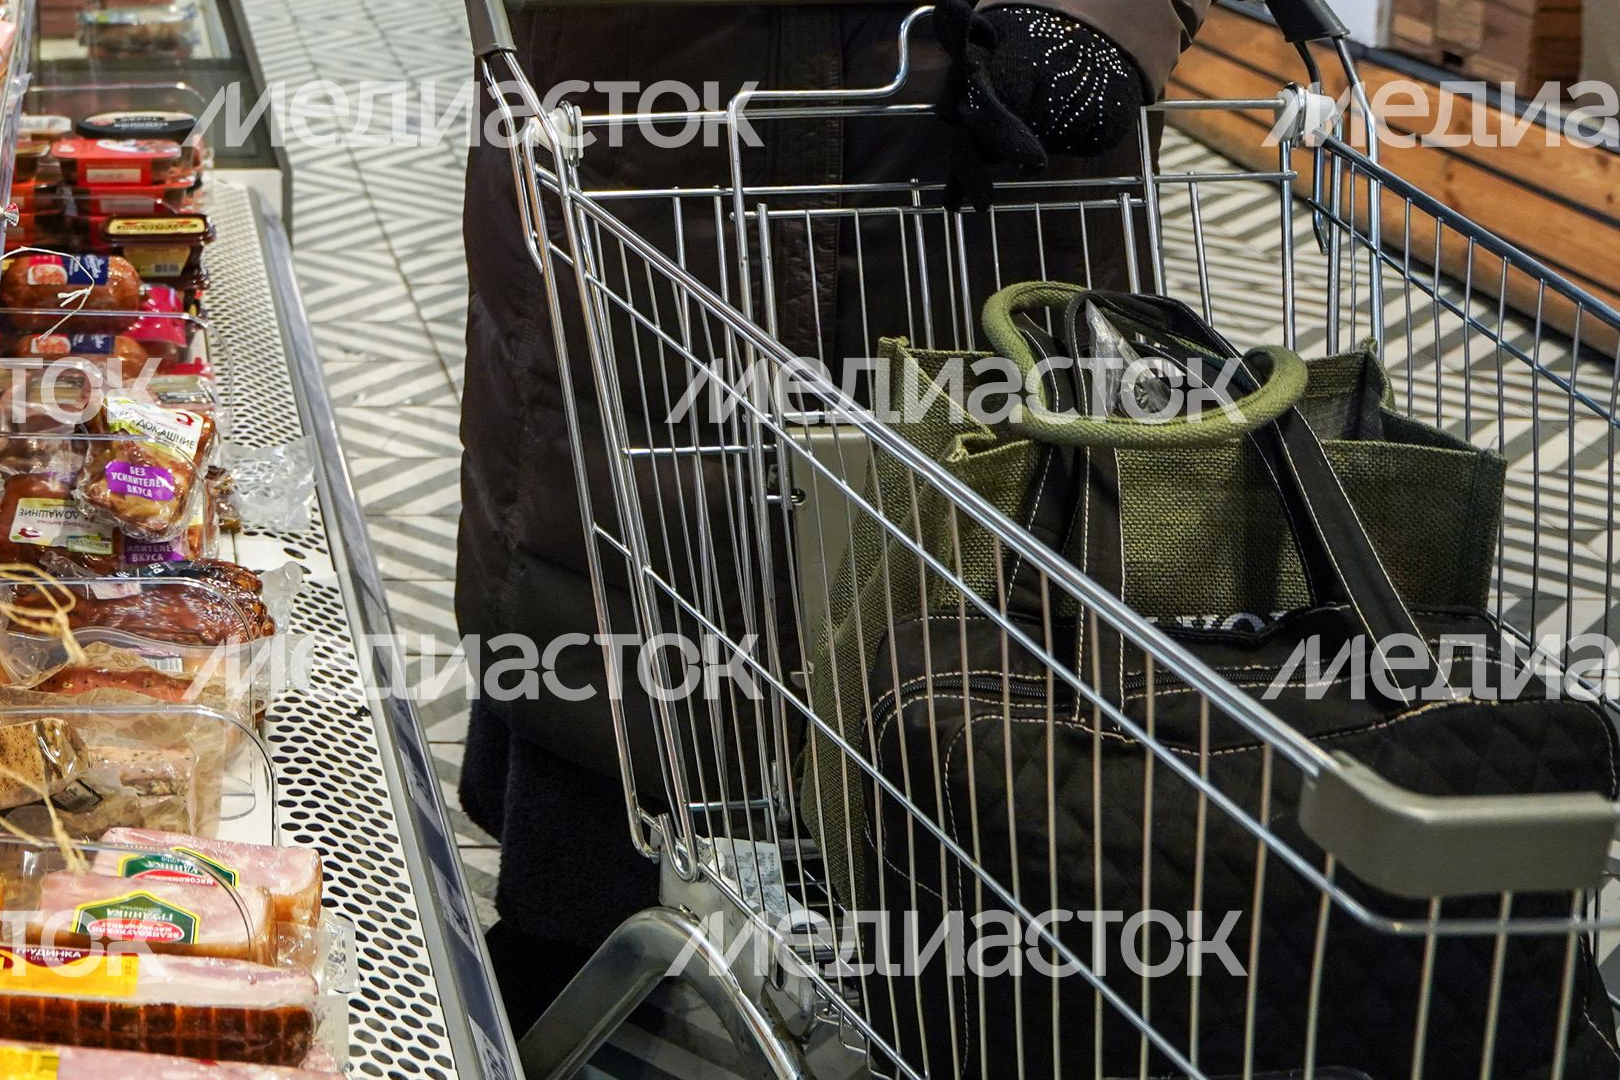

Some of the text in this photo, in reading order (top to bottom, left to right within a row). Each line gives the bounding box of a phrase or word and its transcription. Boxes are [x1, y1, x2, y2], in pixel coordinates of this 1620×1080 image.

[129, 466, 147, 477] БЕЗ
[126, 484, 154, 498] ВКУСА
[18, 508, 80, 519] ДОМАШНИЕ
[131, 553, 164, 563] ВКУСА
[16, 946, 82, 959] ГРУДИНКА
